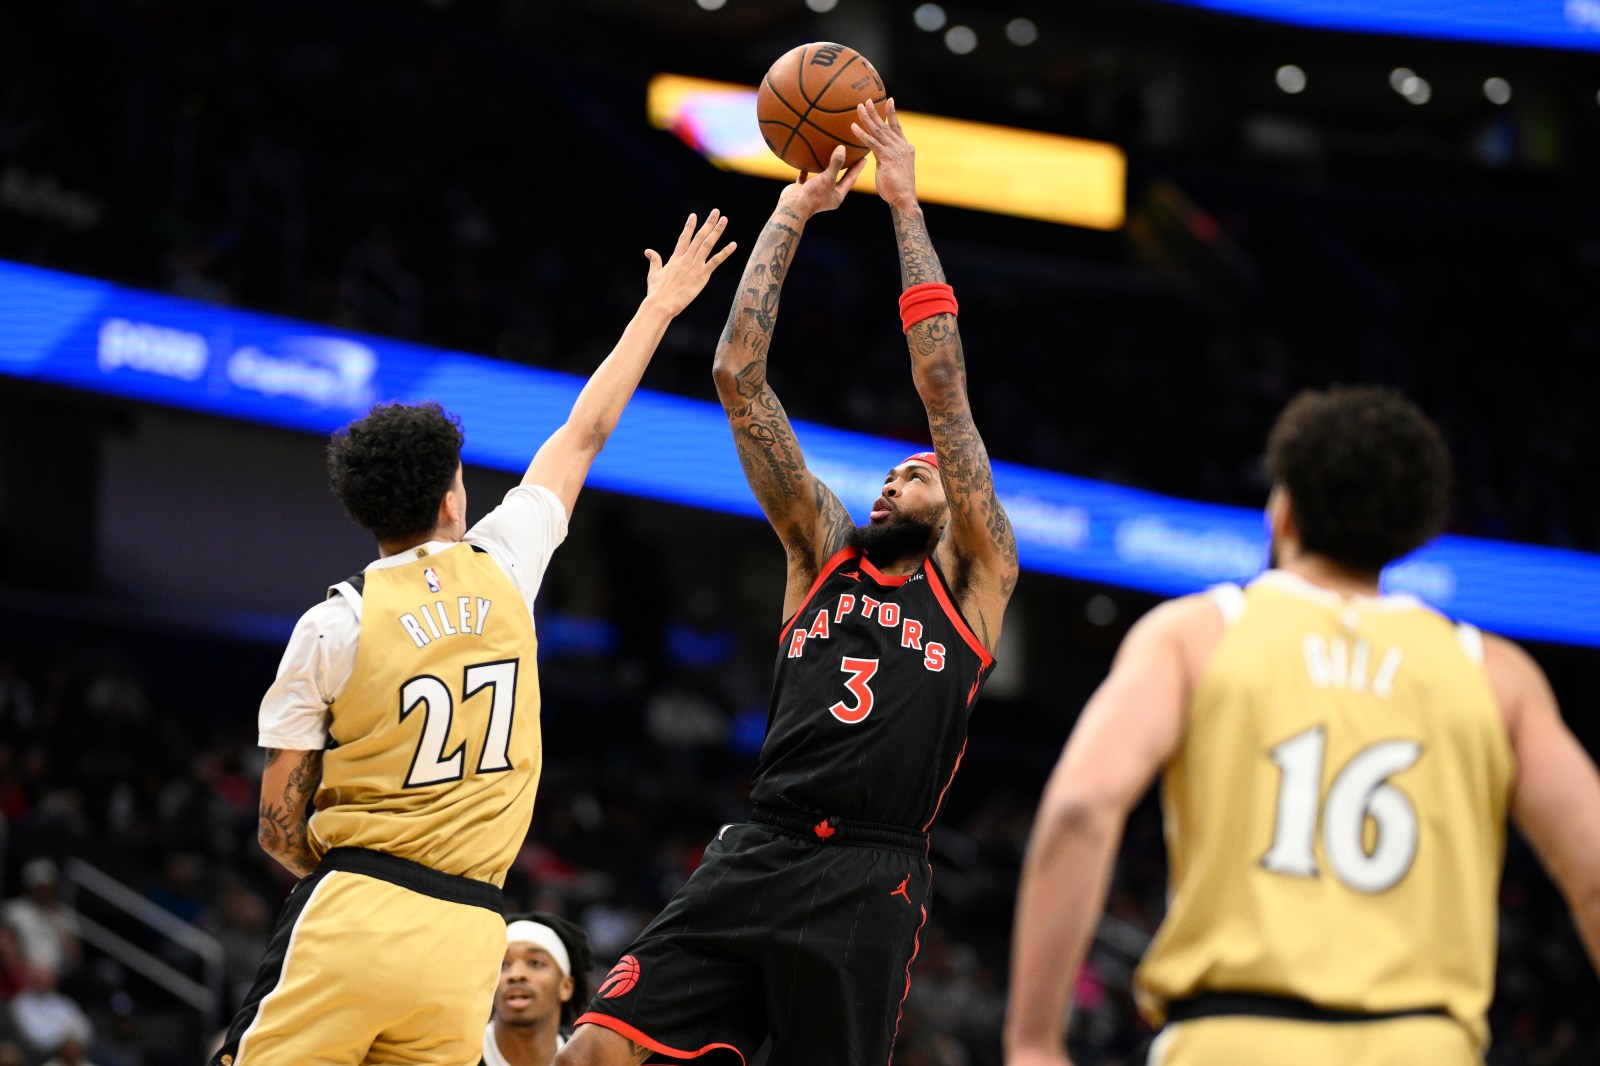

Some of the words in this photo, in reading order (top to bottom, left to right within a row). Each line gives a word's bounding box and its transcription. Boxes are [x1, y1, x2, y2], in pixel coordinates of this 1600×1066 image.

[399, 596, 491, 649] RILEY
[788, 594, 946, 672] RAPTORS
[399, 658, 520, 789] 27
[829, 656, 879, 724] 3
[1259, 722, 1424, 894] 16
